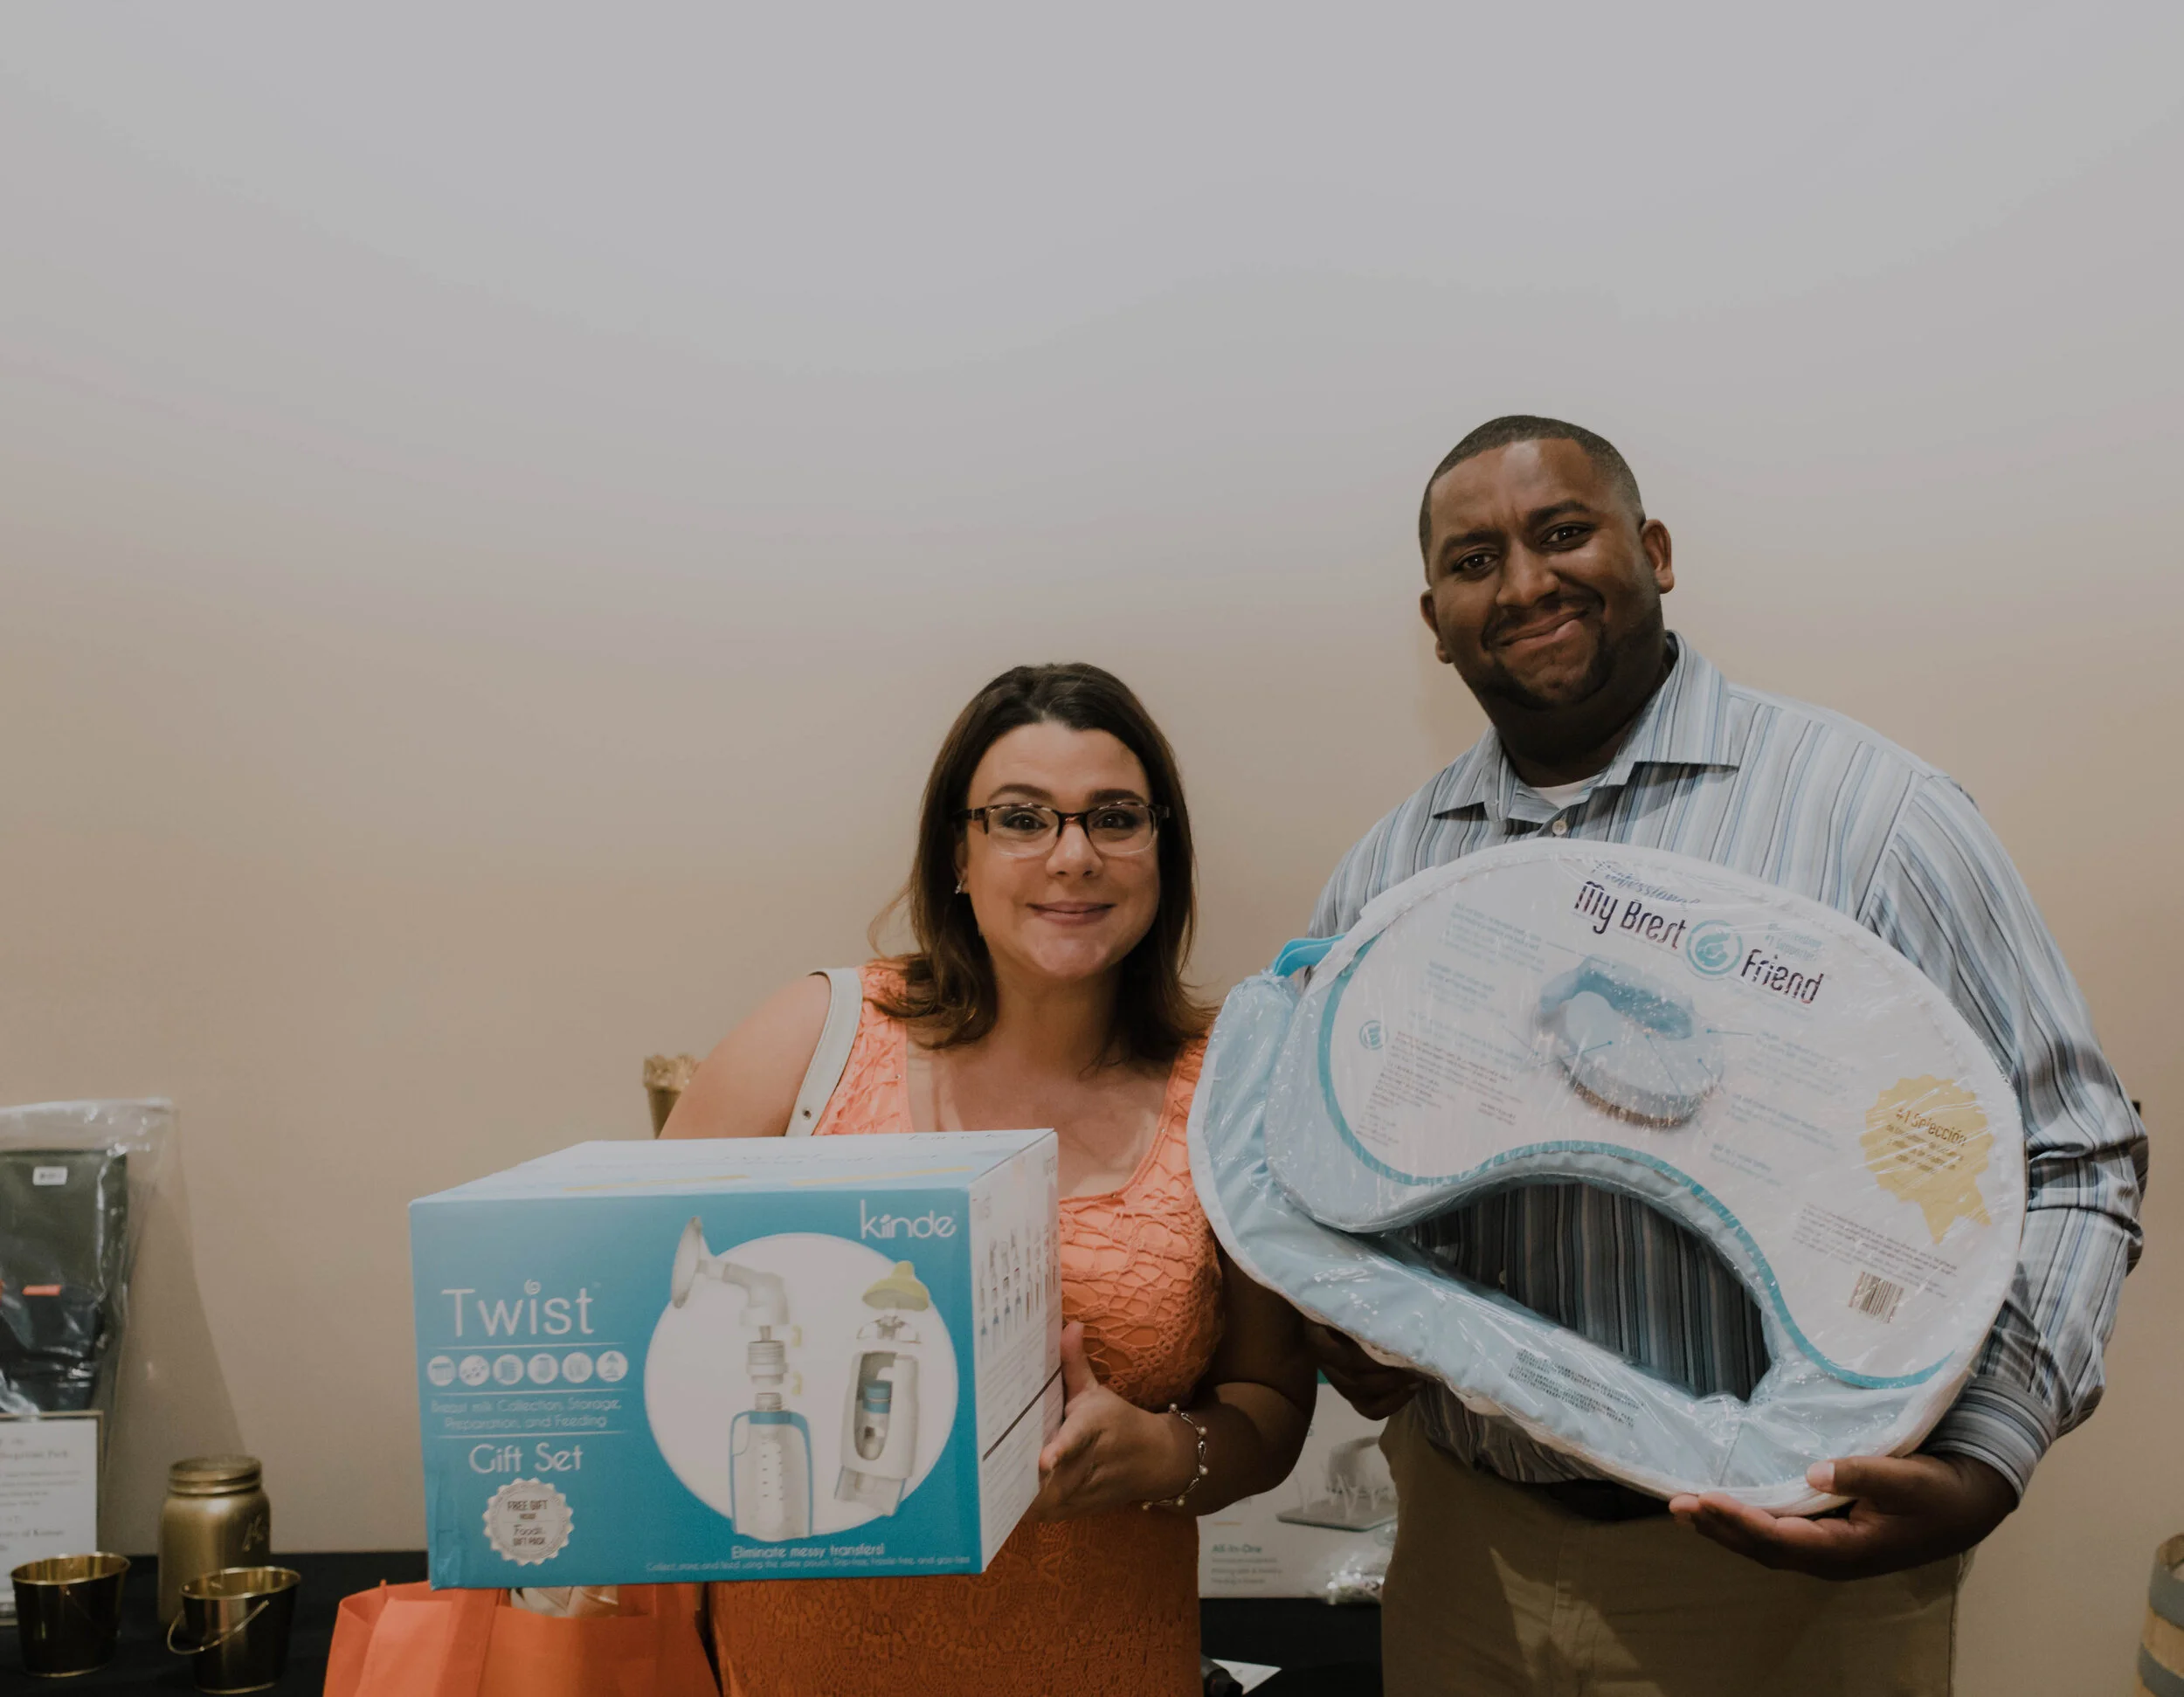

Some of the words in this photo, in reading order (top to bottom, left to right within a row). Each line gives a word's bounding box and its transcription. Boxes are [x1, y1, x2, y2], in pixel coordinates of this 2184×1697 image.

[1573, 880, 1619, 935] My
[1620, 900, 1687, 950] Brest
[1740, 949, 1825, 1004] Friend
[440, 1279, 595, 1338] Twist
[568, 1397, 623, 1412] Storage,
[525, 1415, 552, 1429] and
[555, 1413, 609, 1430] Feeding
[468, 1442, 524, 1473] Gift
[534, 1442, 584, 1473] Set
[507, 1500, 529, 1511] FREE
[529, 1499, 549, 1510] GIFT
[731, 1545, 787, 1560] Eliminate
[790, 1546, 826, 1559] messy
[830, 1542, 885, 1556] transfers!
